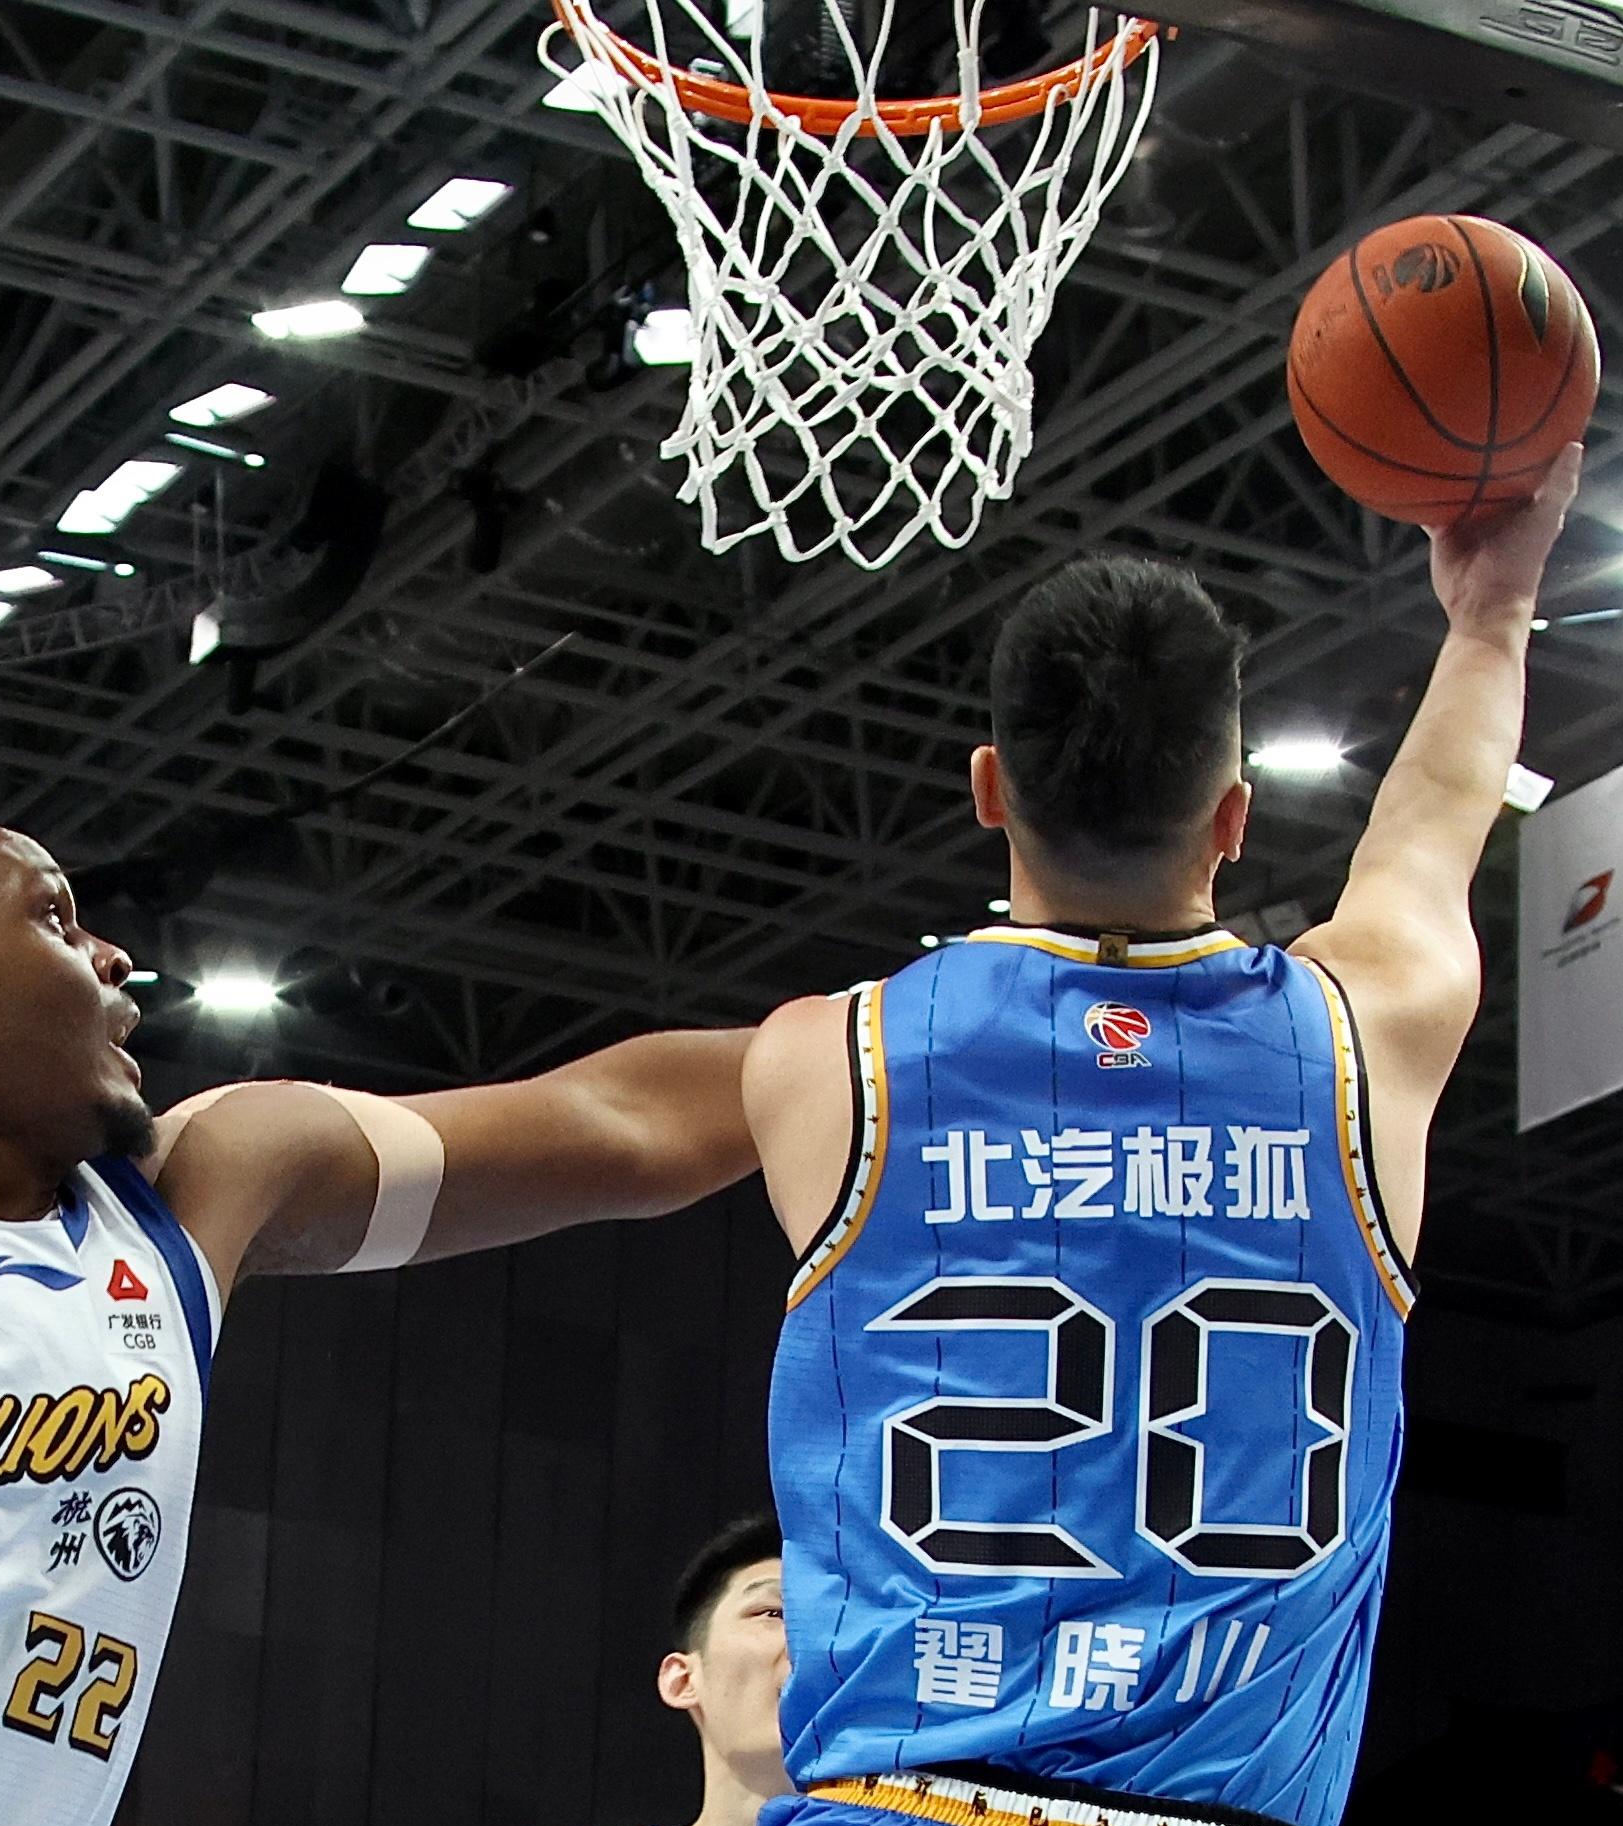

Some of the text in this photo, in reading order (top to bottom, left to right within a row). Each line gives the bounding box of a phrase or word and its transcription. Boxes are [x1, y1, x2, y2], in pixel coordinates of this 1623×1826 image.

[1096, 1051, 1152, 1069] CBA
[921, 1125, 1311, 1225] 北汽极狐
[108, 1313, 162, 1331] 广发银行
[123, 1333, 157, 1350] CGB
[863, 1276, 1360, 1580] 20
[3, 1611, 138, 1762] 22
[913, 1617, 1270, 1710] 翟晓川
